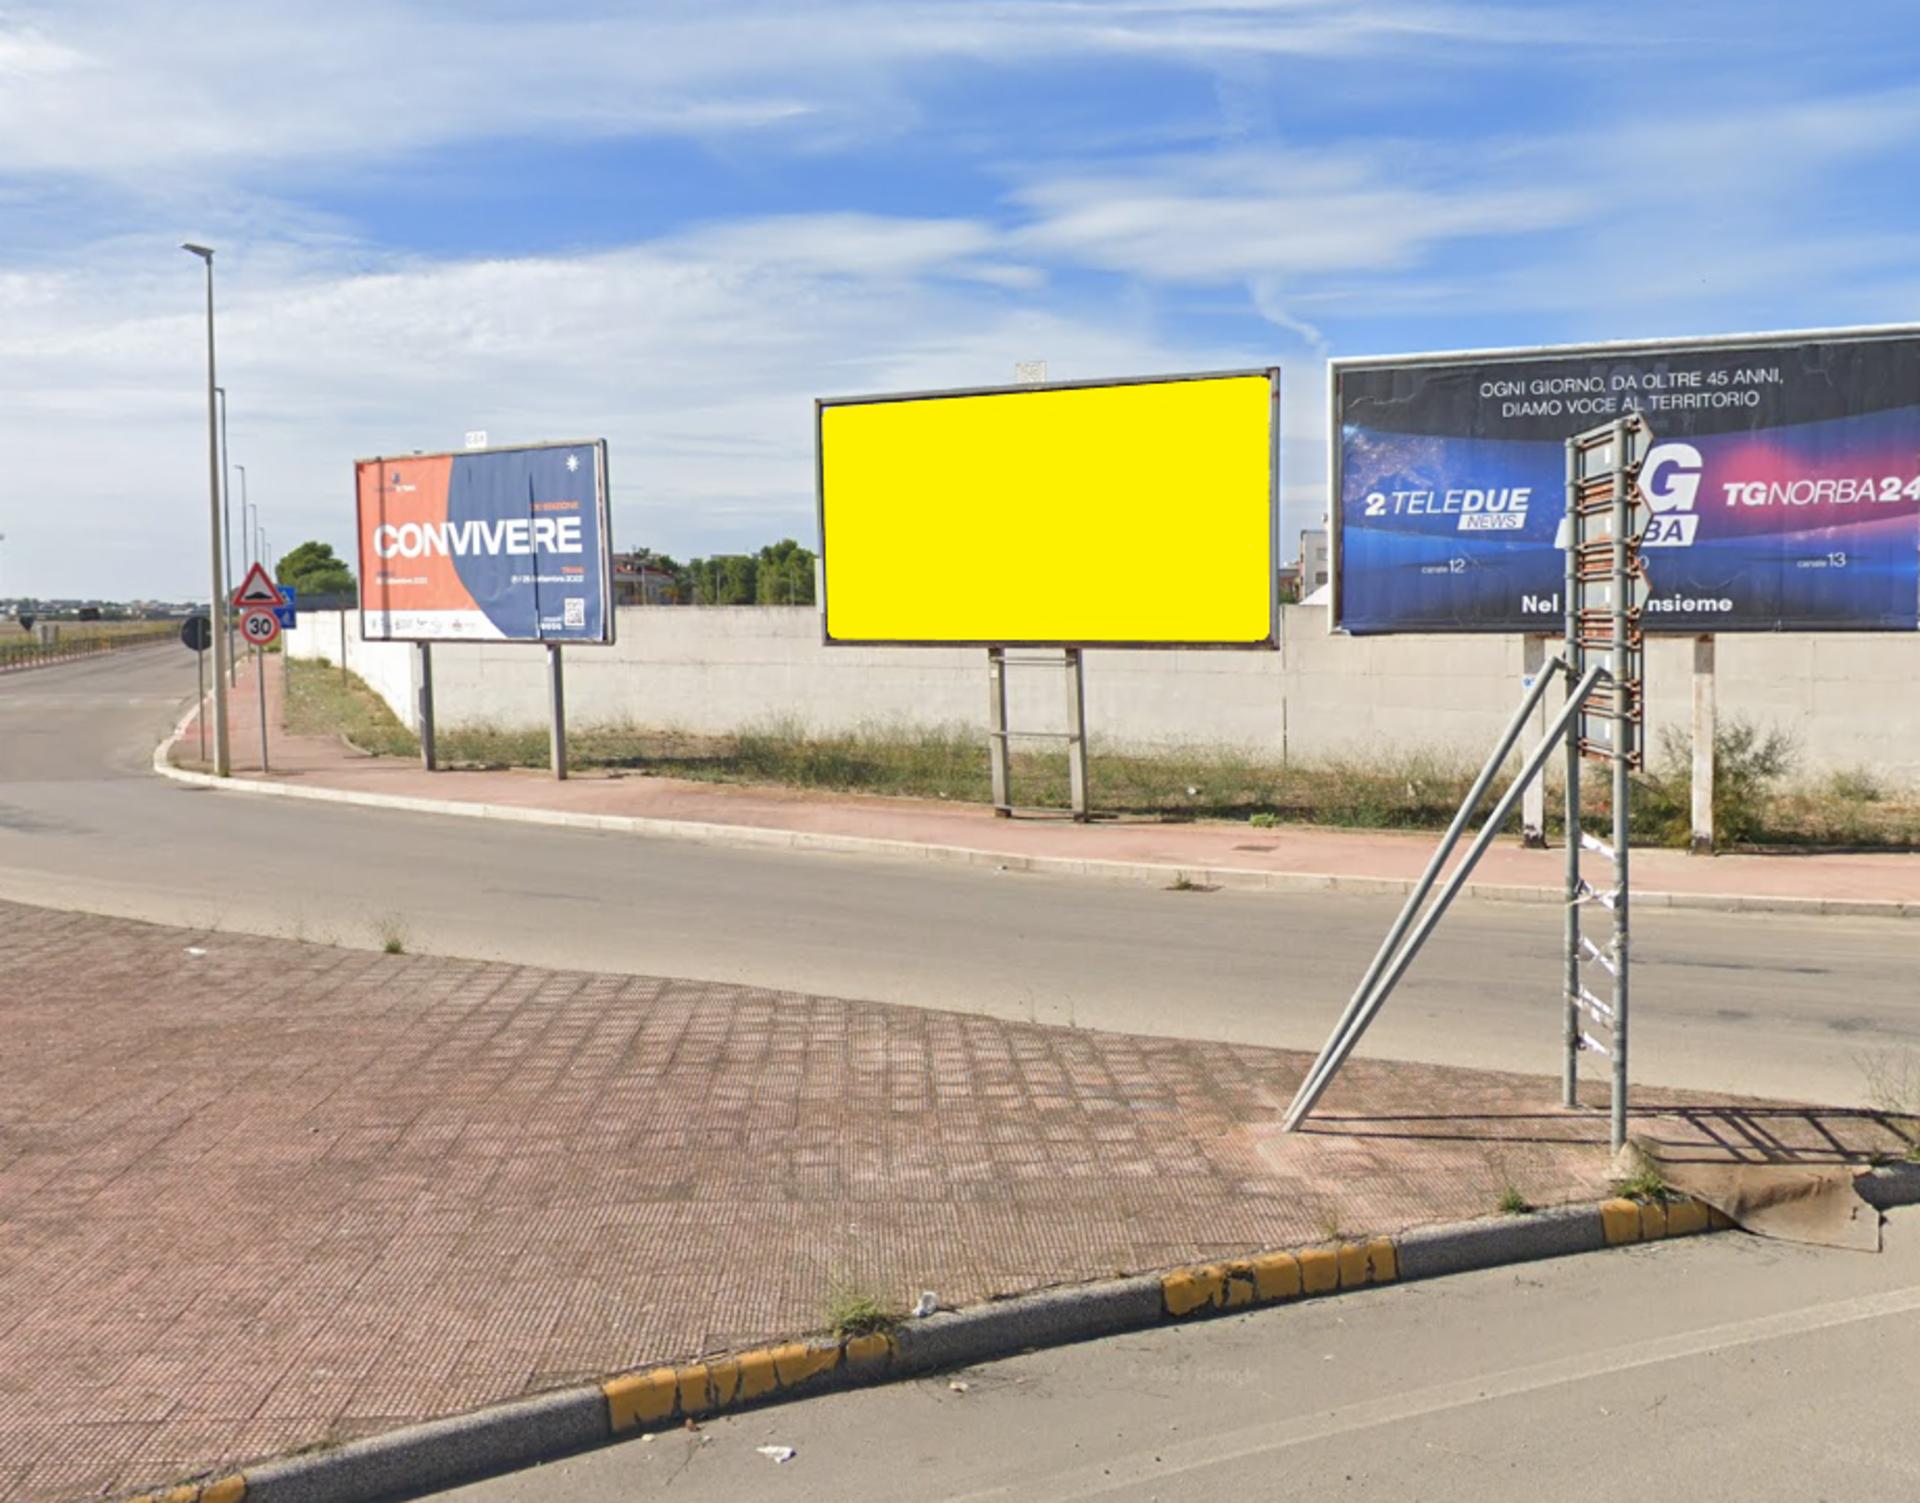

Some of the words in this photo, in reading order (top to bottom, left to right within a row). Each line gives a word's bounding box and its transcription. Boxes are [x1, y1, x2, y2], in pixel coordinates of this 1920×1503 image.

[1479, 380, 1525, 398] OGNI
[1529, 377, 1606, 396] GIORNO,
[1612, 375, 1638, 391] DA
[1642, 371, 1701, 389] OLTRE
[1706, 371, 1729, 386] 45
[1732, 368, 1784, 385] ANNI,
[1502, 401, 1562, 418] DIAMO
[1567, 398, 1616, 414] VOCE
[1621, 397, 1643, 412] AL
[1651, 390, 1760, 410] TERRITORIO
[1637, 442, 1703, 513] G
[1392, 488, 1532, 514] TELEDUE
[1467, 515, 1517, 528] NEWS
[374, 517, 583, 558] CONVIVERE
[1449, 558, 1466, 574] 12
[1826, 552, 1847, 568] 13
[1521, 594, 1558, 613] Nel
[1647, 594, 1733, 612] nsieme
[250, 618, 273, 635] 30
